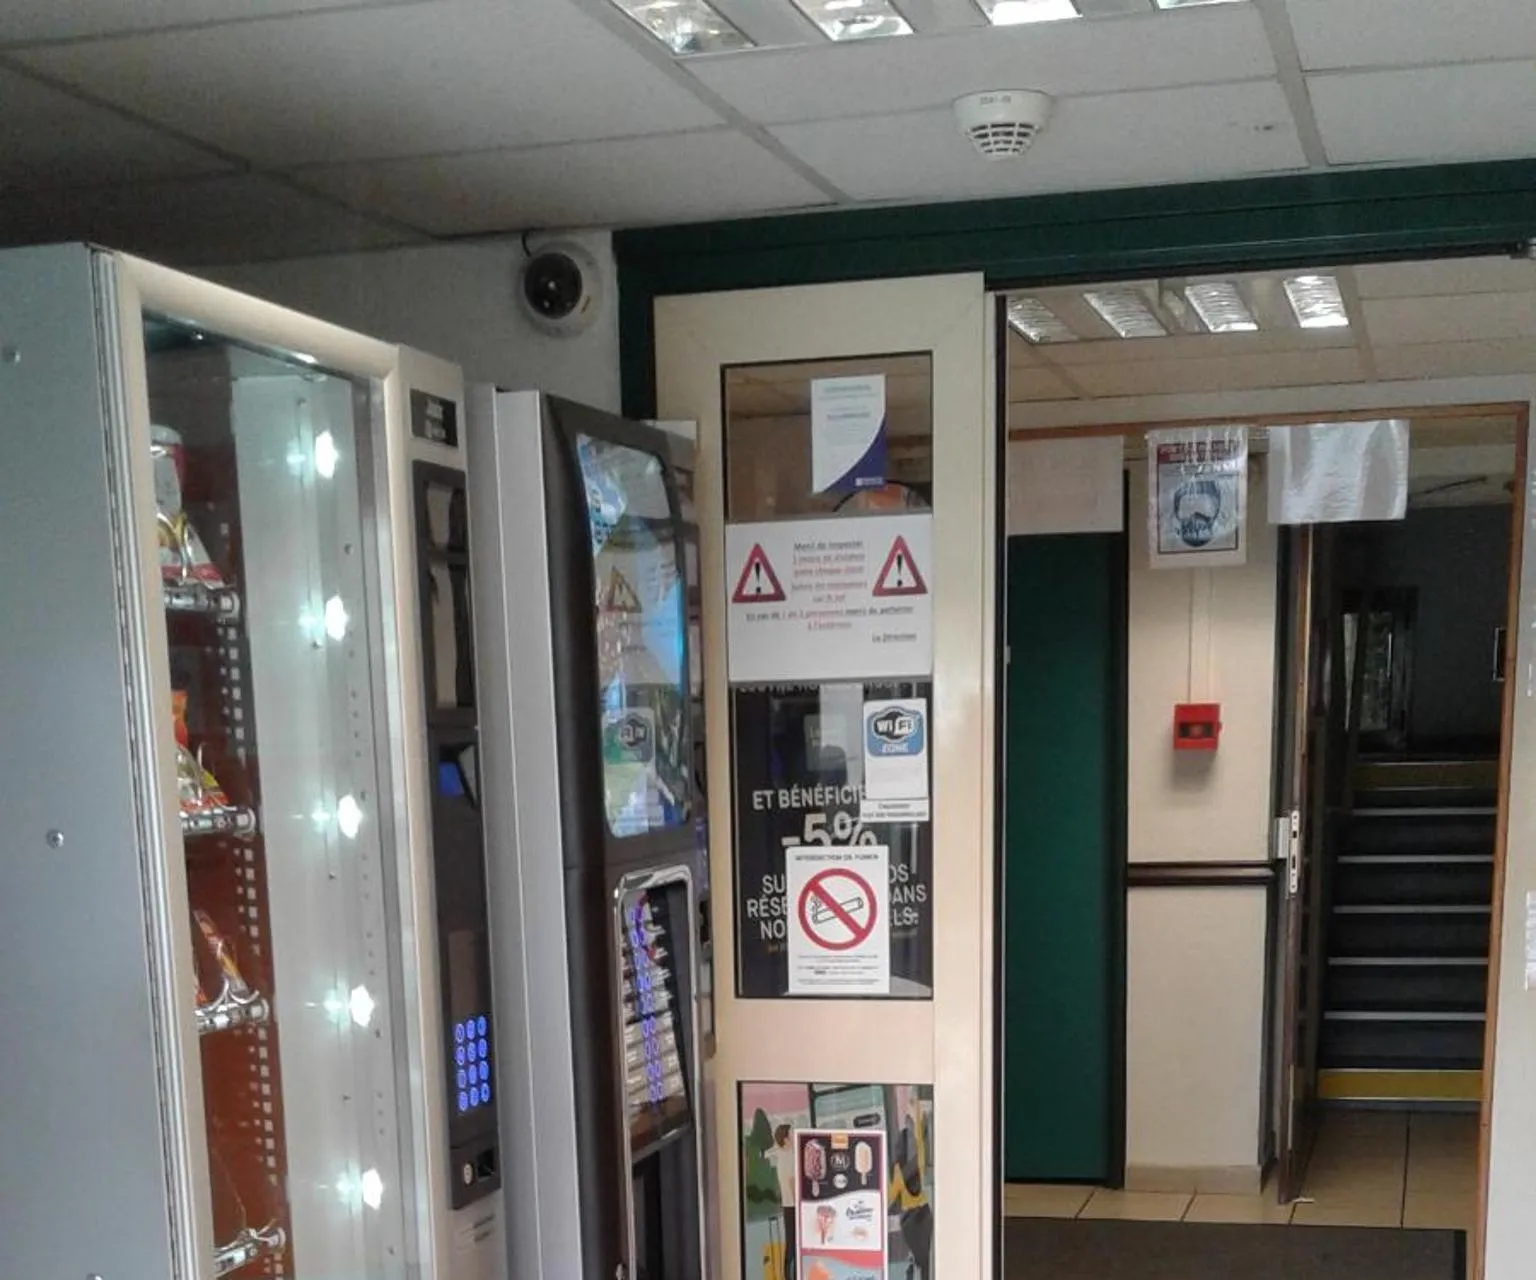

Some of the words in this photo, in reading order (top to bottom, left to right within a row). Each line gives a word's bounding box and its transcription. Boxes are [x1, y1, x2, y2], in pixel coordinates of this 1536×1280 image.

[752, 789, 774, 810] ET
[778, 783, 866, 809] BÉNÉFICIE
[762, 873, 786, 895] SU
[889, 863, 909, 884] OS
[889, 884, 927, 905] ANS
[760, 919, 786, 941] NO
